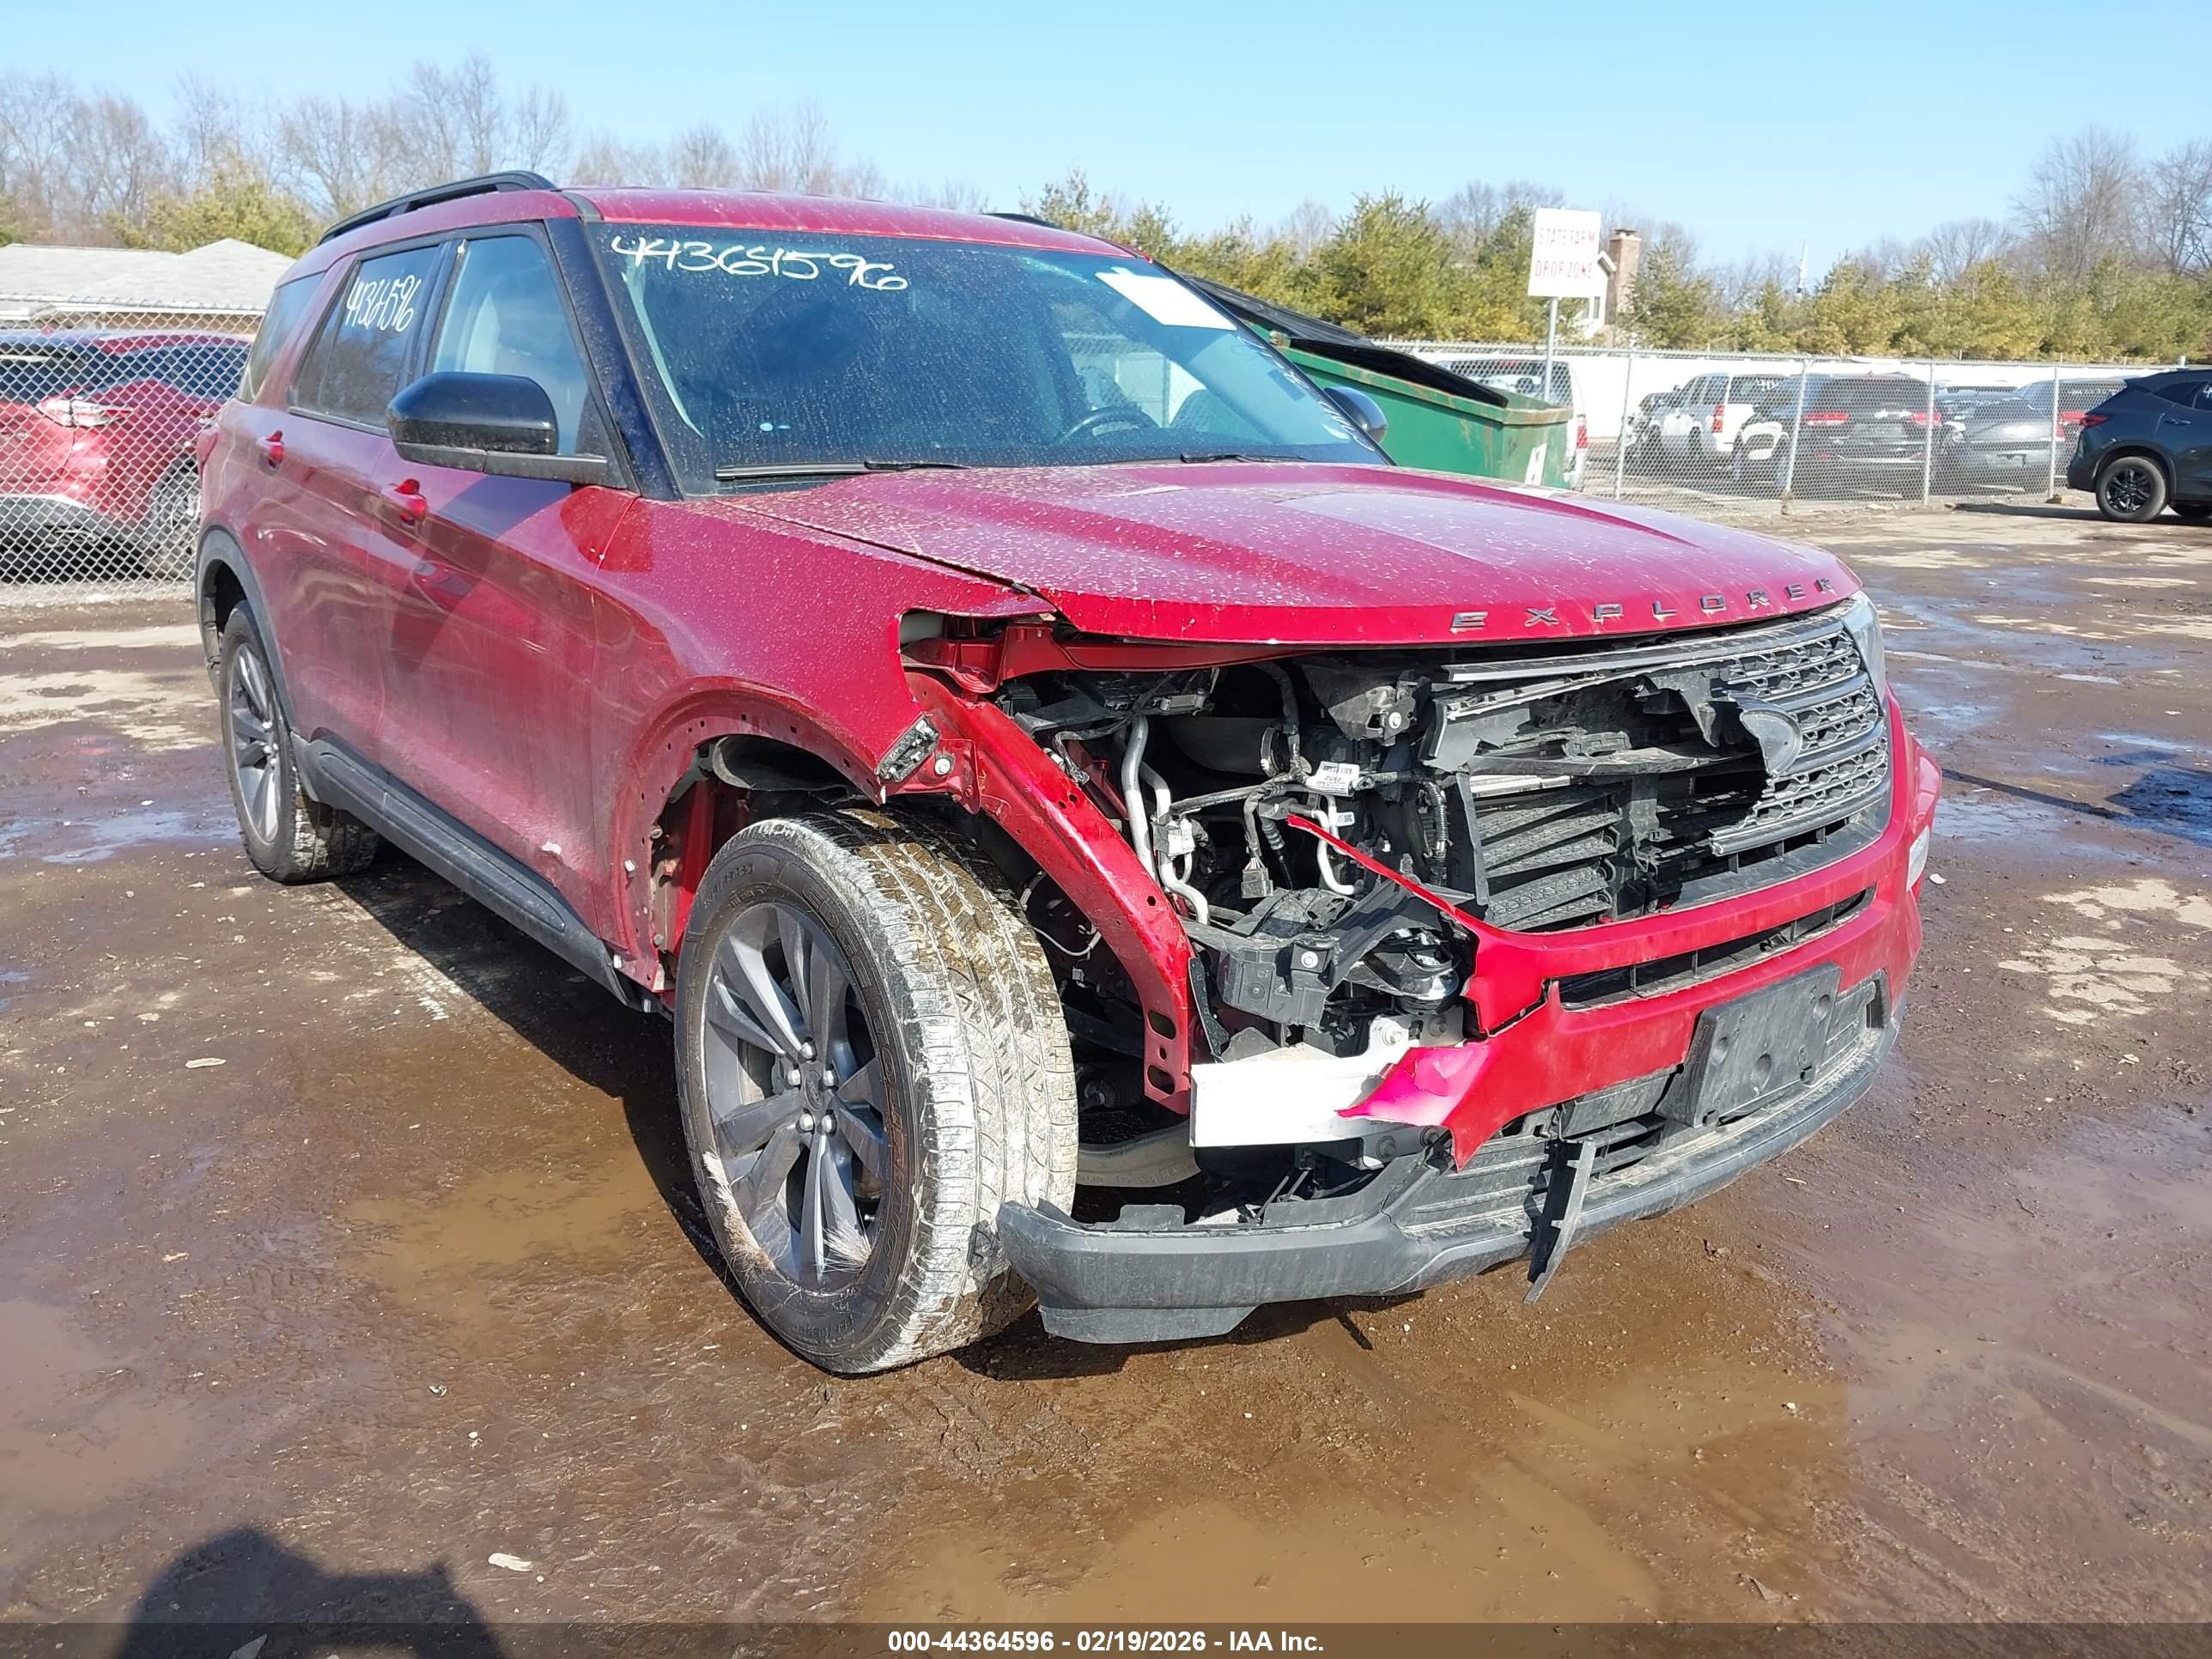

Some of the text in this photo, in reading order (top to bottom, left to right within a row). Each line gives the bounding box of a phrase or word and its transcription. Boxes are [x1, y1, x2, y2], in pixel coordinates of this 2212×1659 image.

[611, 235, 908, 290] 44364596
[1449, 576, 1836, 634] EXPLORER
[802, 883, 872, 989] EDGE
